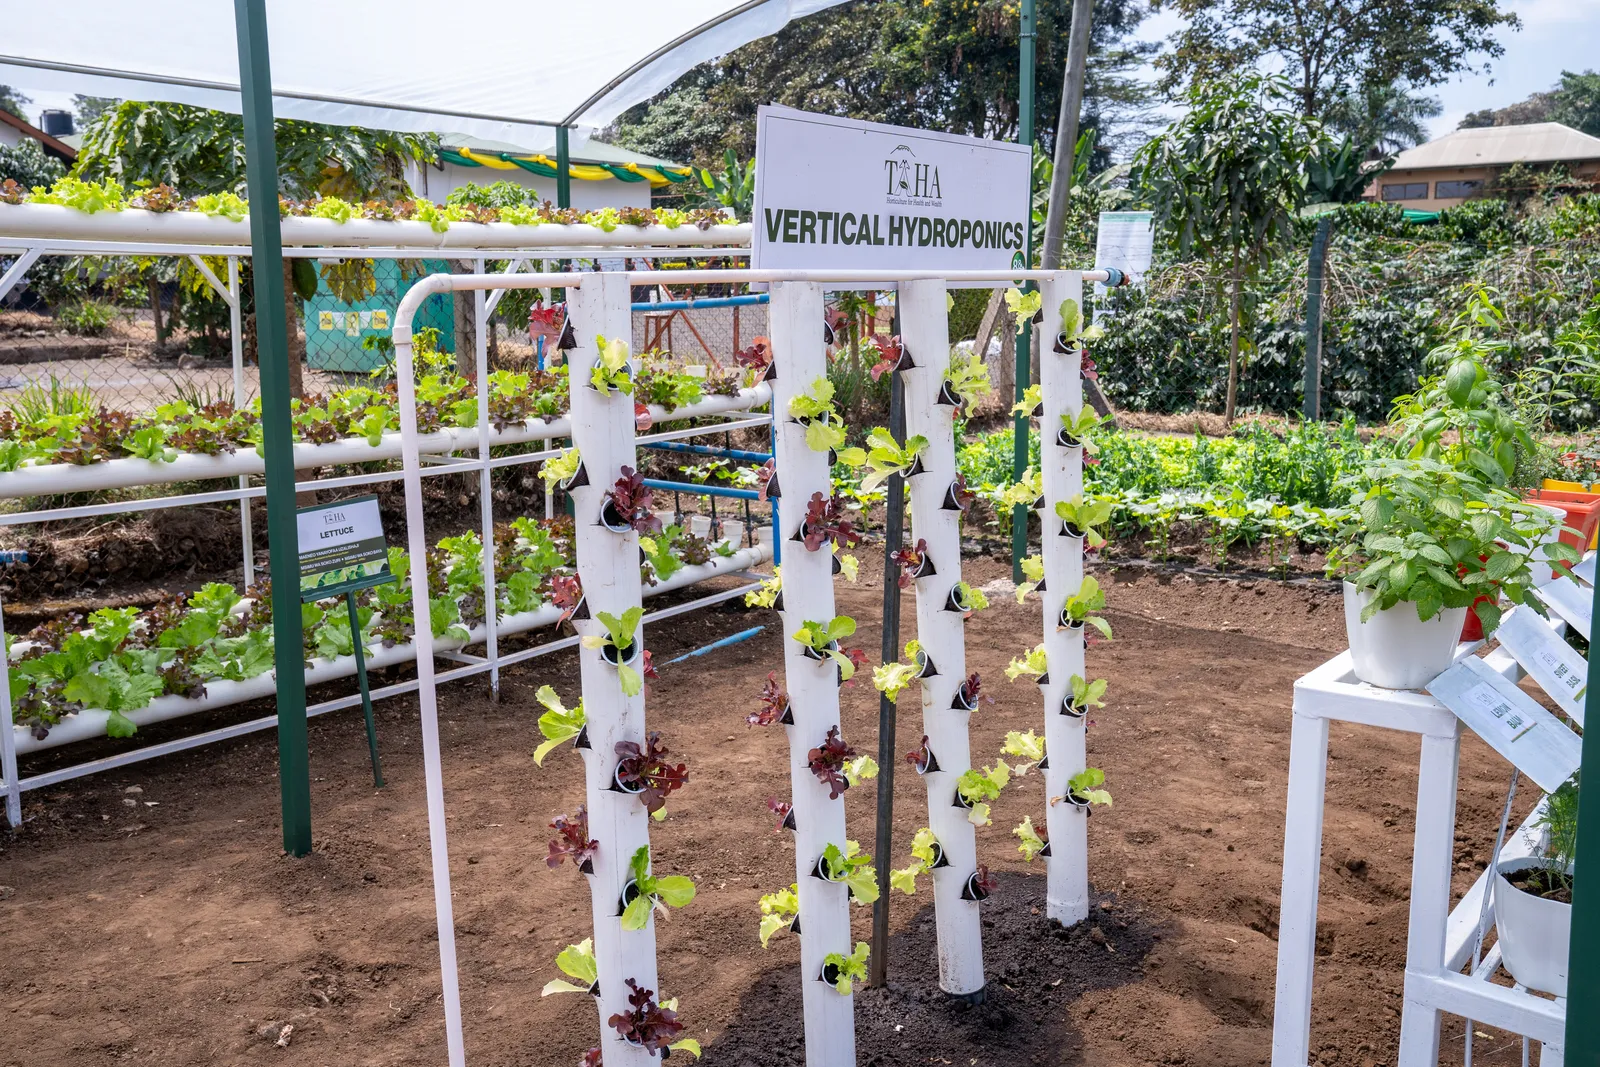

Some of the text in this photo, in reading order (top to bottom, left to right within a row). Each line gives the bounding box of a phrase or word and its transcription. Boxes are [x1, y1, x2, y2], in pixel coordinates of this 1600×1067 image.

[884, 159, 942, 199] TAHA
[886, 197, 907, 205] Horticulture
[764, 208, 1024, 249] VERTICAL HYDROPONICS
[320, 526, 354, 539] LETTUCE
[1554, 663, 1570, 679] SWEET
[1565, 675, 1581, 689] BASIL
[1490, 702, 1512, 718] LEMON
